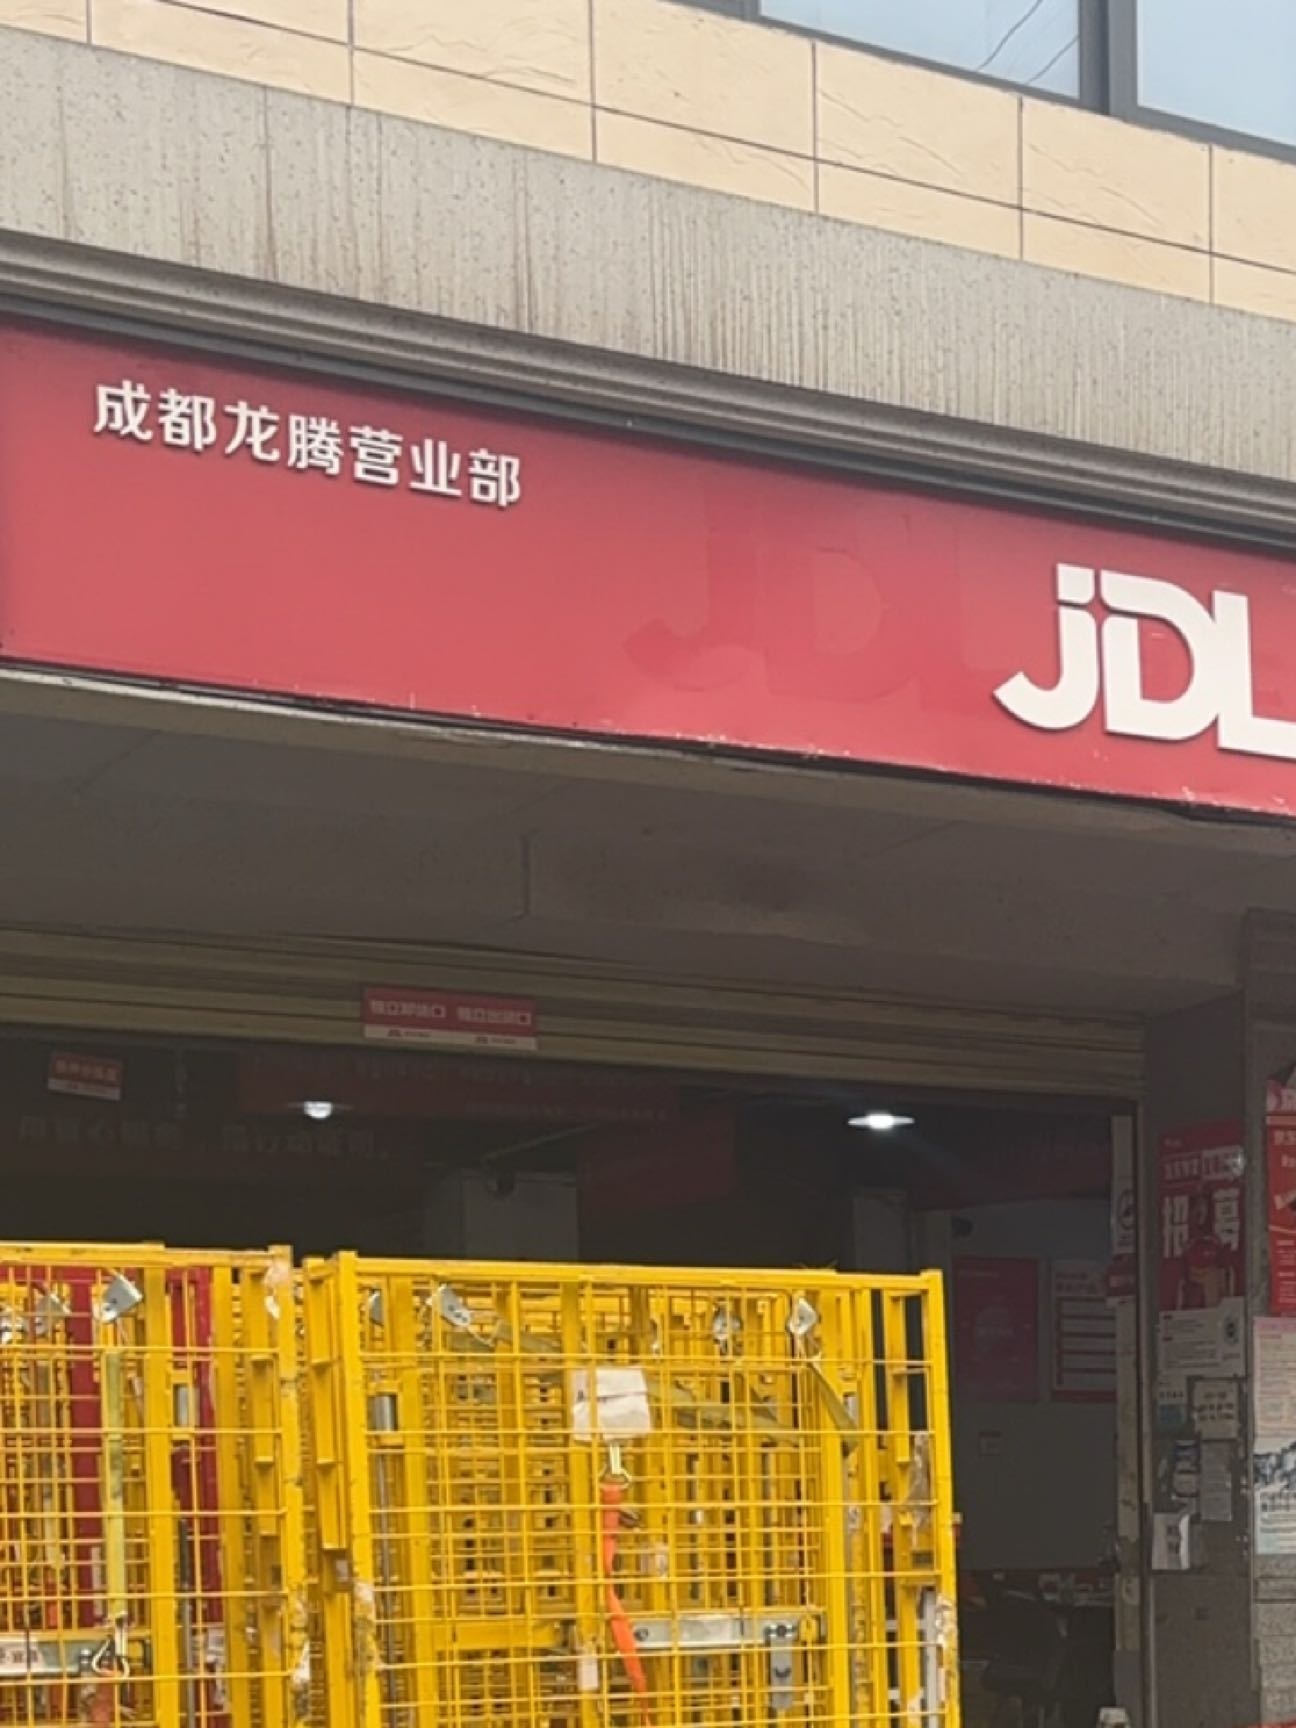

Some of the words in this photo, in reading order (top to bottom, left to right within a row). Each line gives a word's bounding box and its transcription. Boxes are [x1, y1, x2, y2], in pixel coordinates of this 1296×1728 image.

[93, 379, 522, 507] 成都龙腾营业部
